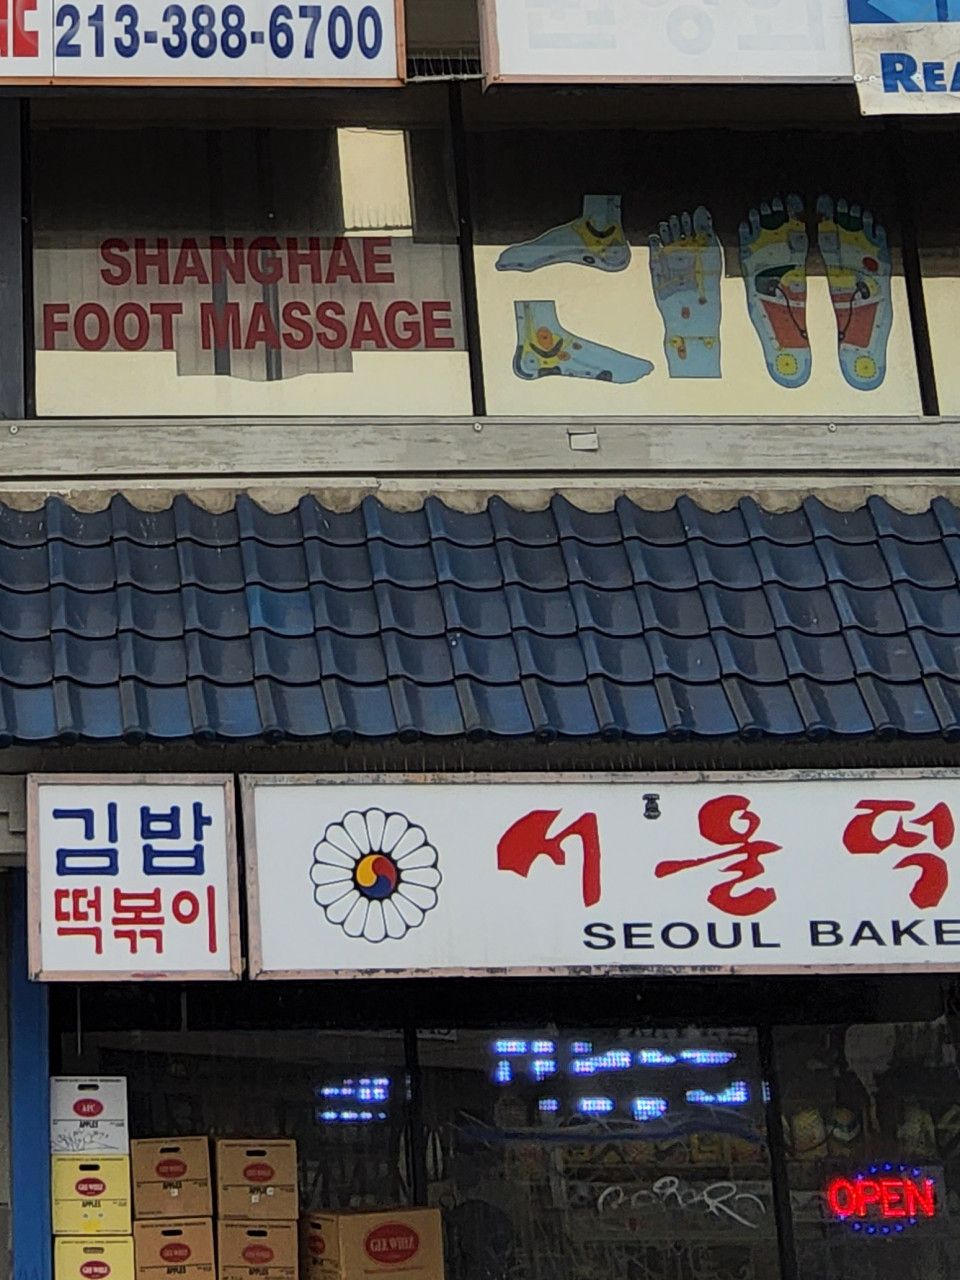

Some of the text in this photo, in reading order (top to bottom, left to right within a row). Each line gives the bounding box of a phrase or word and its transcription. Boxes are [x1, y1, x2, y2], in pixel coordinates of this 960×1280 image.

[55, 4, 382, 60] 213-388-6700
[100, 235, 395, 285] SHANGHAE
[42, 300, 455, 351] FOOT MASSAGE
[52, 801, 212, 876] 김밥
[53, 885, 218, 954] 떡볶이
[583, 919, 960, 951] SEOUL BAKE
[828, 1178, 934, 1217] OPEN
